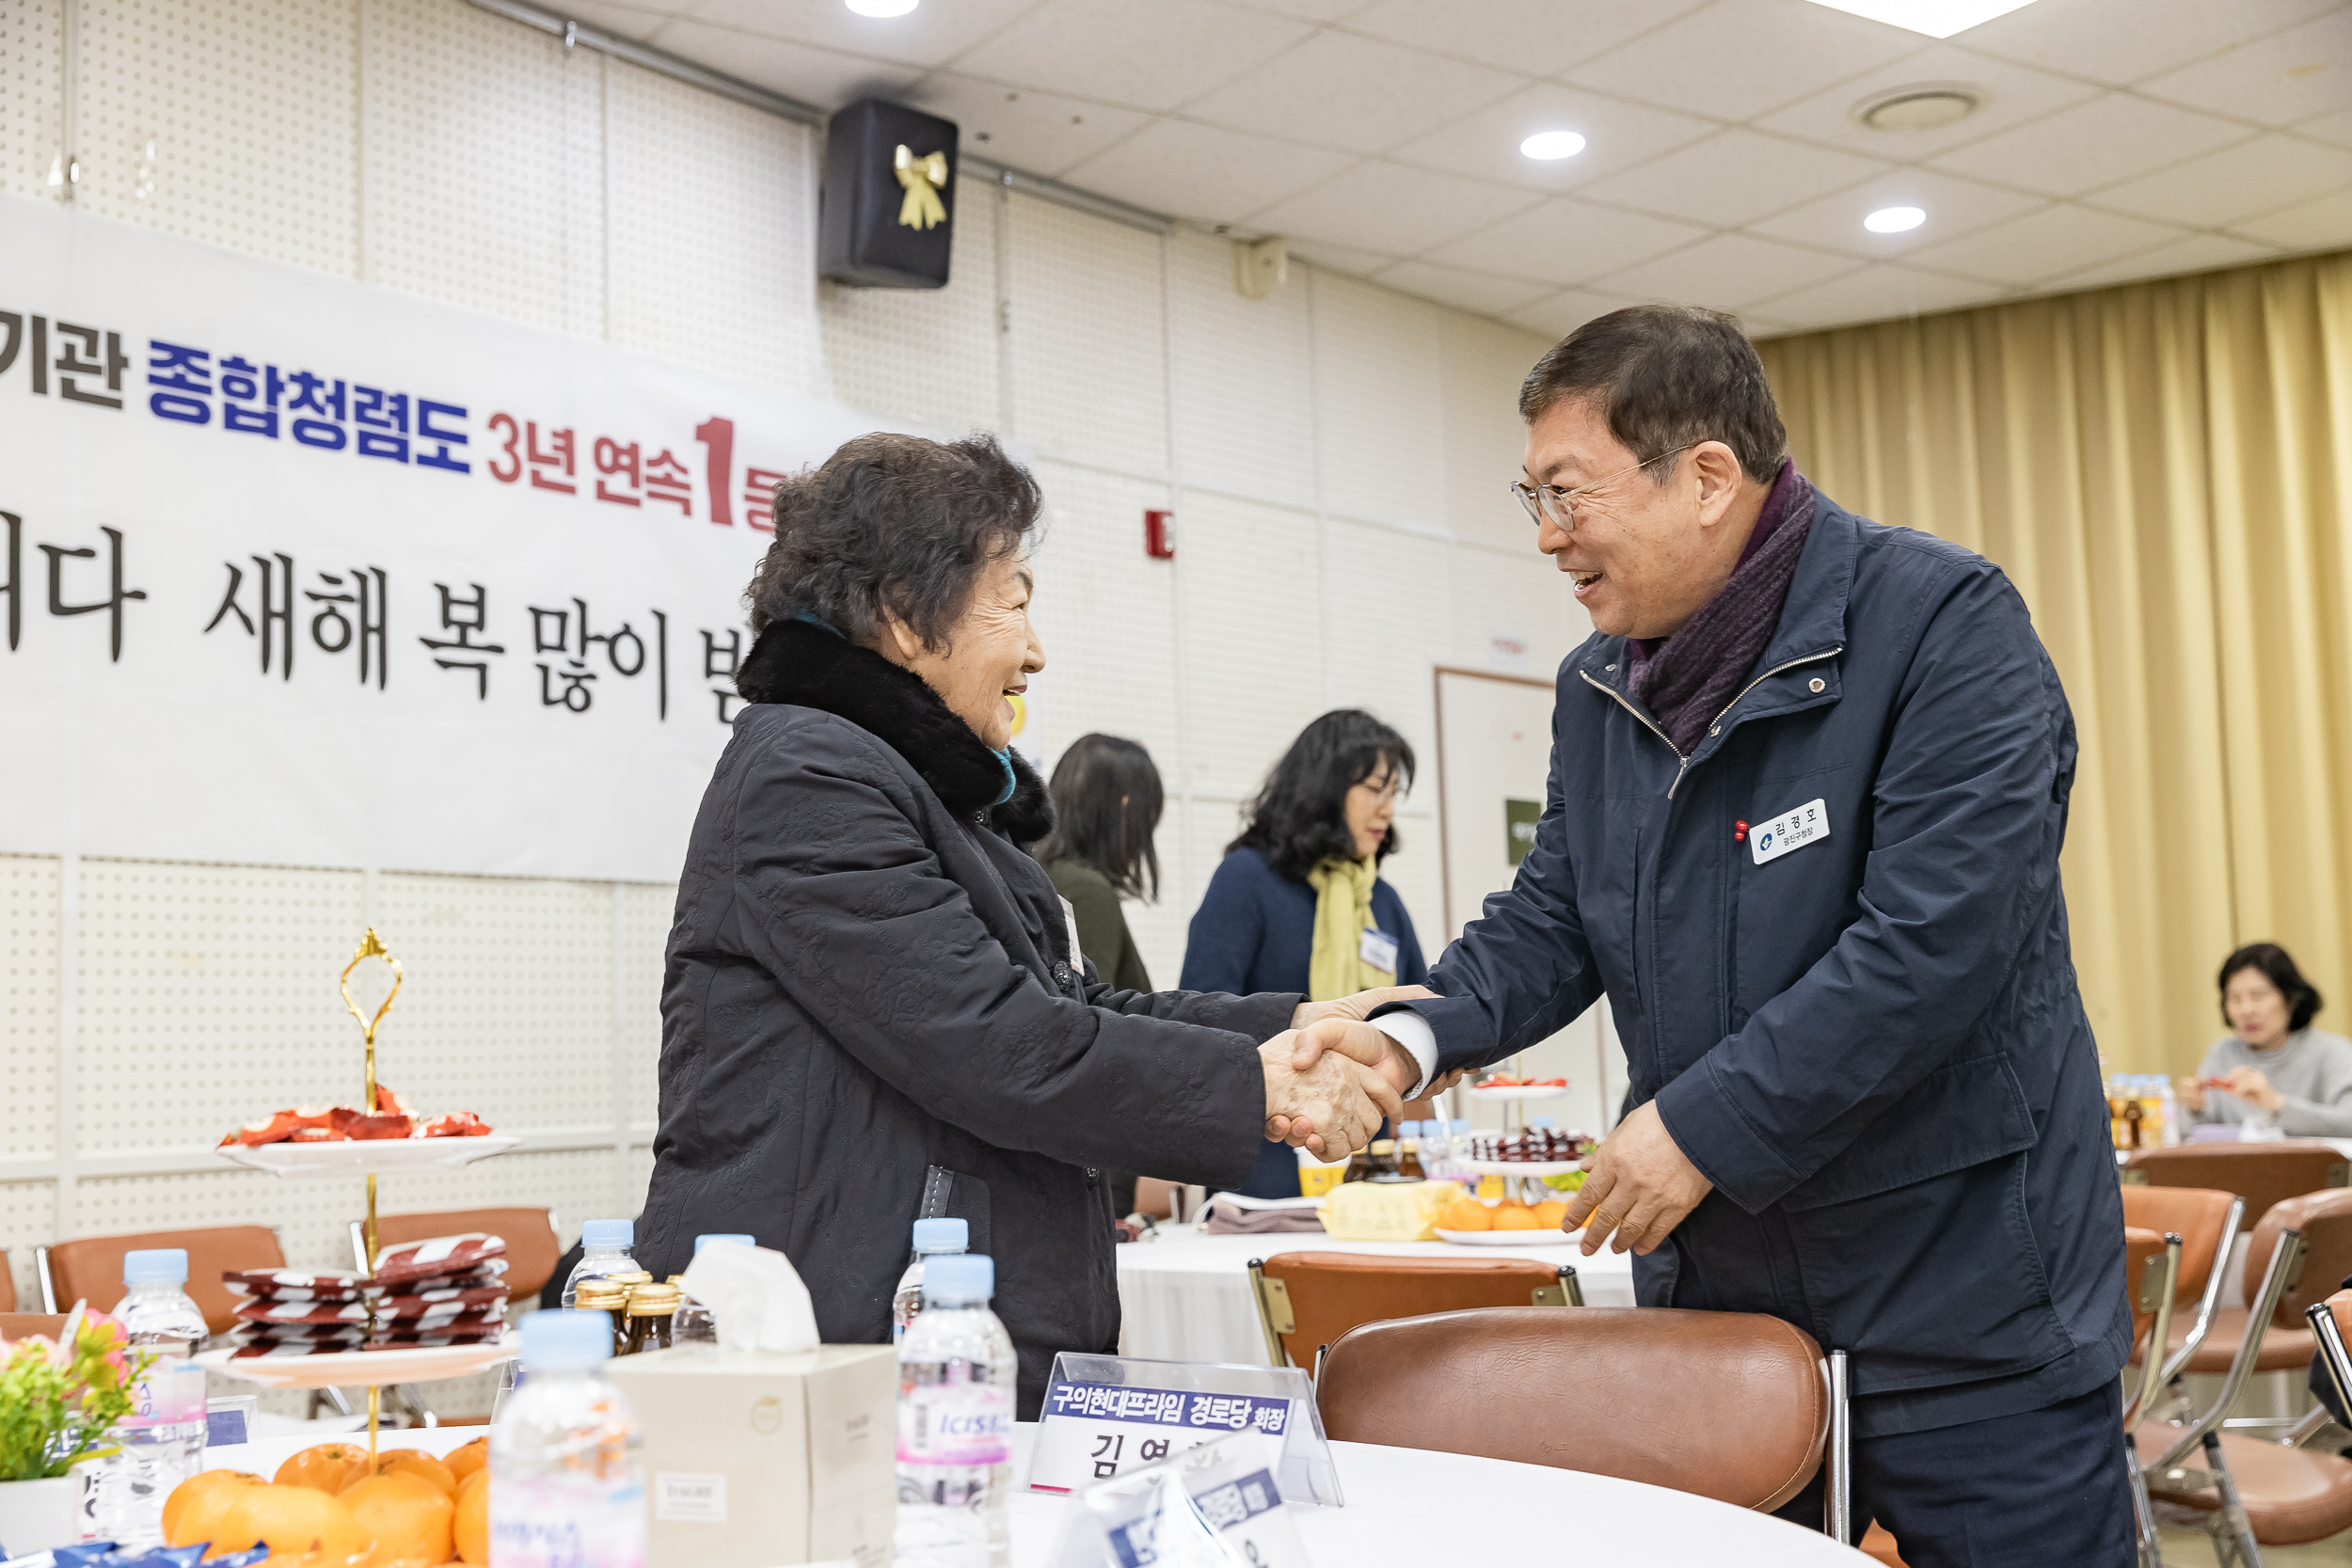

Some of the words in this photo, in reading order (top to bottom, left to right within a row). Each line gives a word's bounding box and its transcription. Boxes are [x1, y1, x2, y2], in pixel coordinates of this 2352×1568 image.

[147, 339, 471, 475] 종합청렴도
[487, 413, 577, 496] 3년
[203, 551, 388, 691] 새해
[419, 582, 505, 701] 복
[527, 596, 668, 721] 많이
[1053, 1385, 1186, 1423] 구의현대프라임
[1189, 1395, 1253, 1429] 경로당
[1252, 1407, 1287, 1433] 회장
